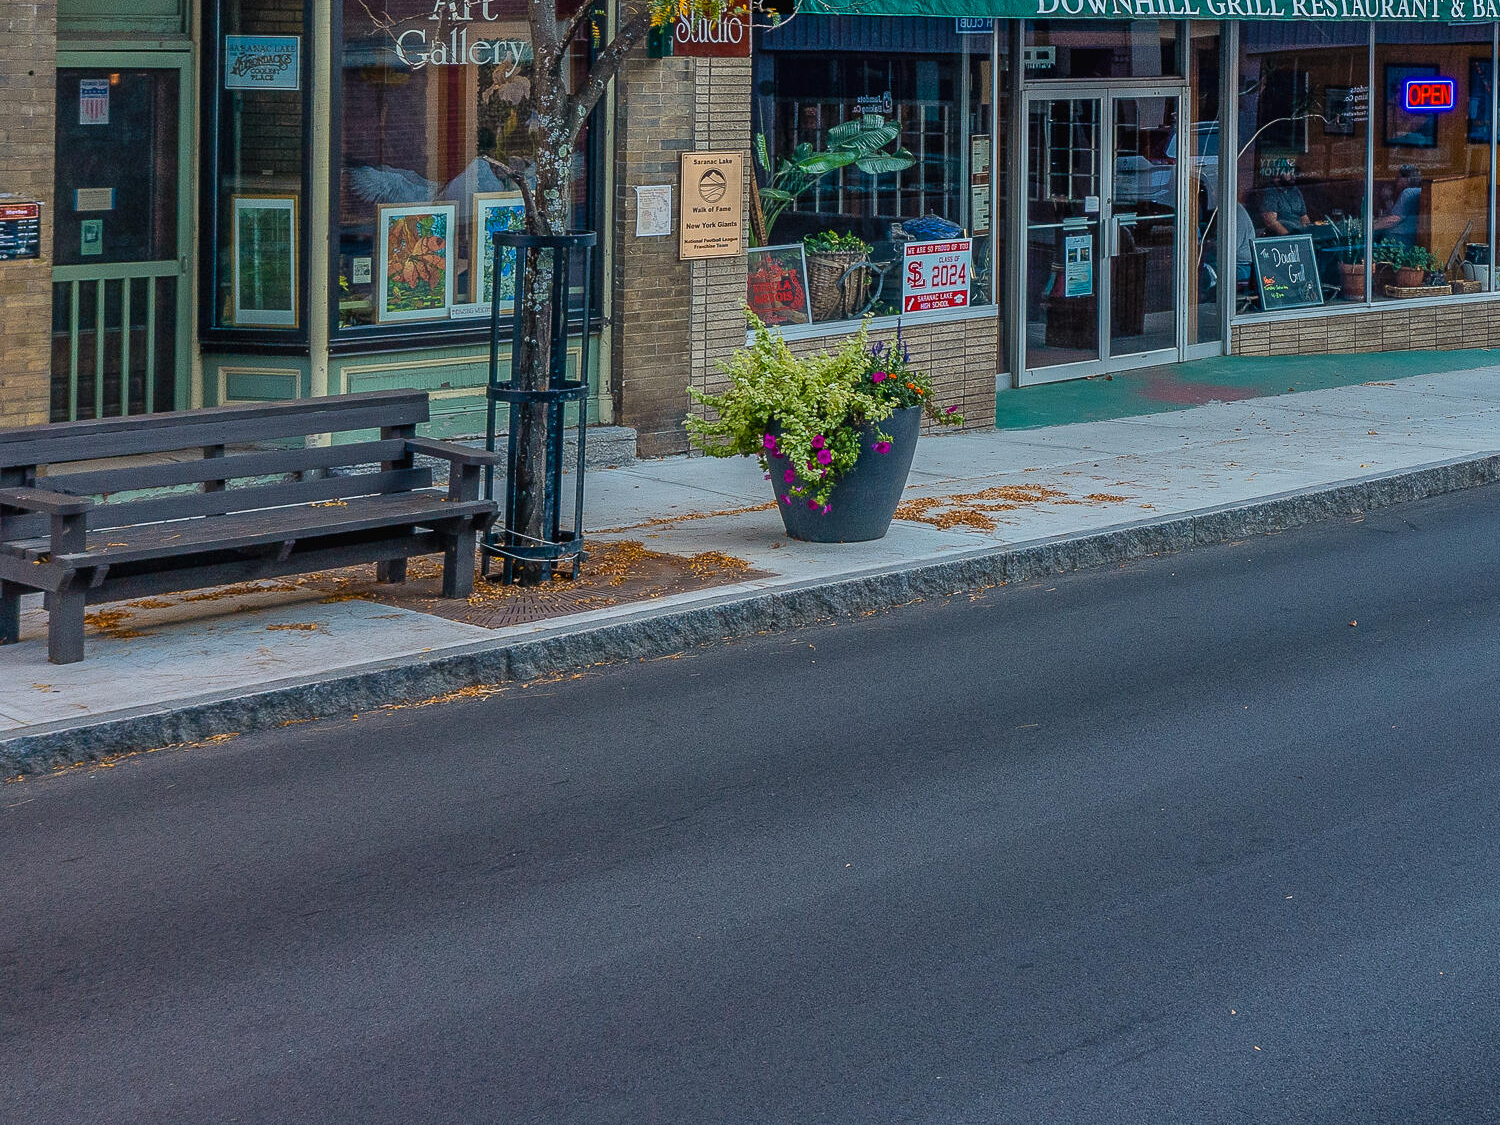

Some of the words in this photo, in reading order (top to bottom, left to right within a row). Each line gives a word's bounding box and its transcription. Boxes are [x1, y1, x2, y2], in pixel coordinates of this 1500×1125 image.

[396, 27, 527, 78] Gallery
[1408, 83, 1451, 106] OPEN
[702, 221, 716, 229] York
[916, 246, 926, 254] ARE
[935, 244, 950, 252] PROUD
[932, 263, 967, 287] 2024
[753, 280, 792, 293] STELLA
[755, 291, 793, 303] ARTOIS
[917, 294, 939, 303] SARANAC
[940, 292, 953, 300] LAKE
[932, 300, 949, 308] SCHOOL
